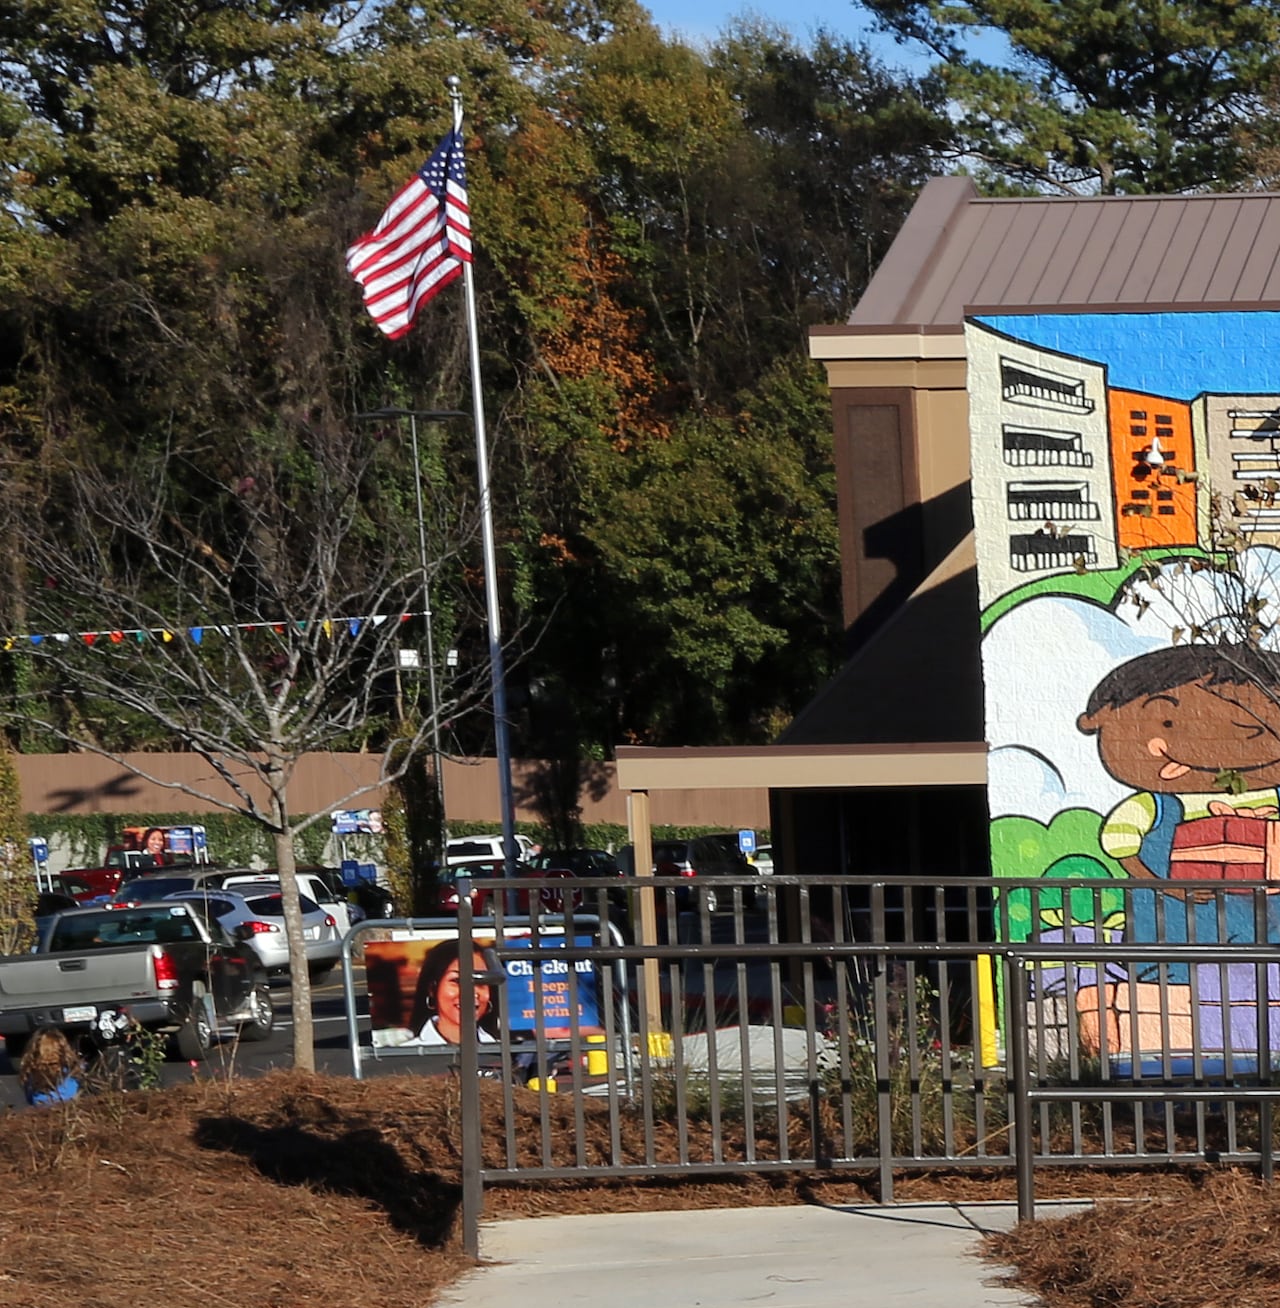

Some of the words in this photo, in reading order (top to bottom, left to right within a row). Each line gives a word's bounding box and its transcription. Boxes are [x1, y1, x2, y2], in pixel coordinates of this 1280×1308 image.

[507, 959, 592, 975] Chckut
[527, 981, 570, 994] eep
[522, 1004, 583, 1018] mvin!
